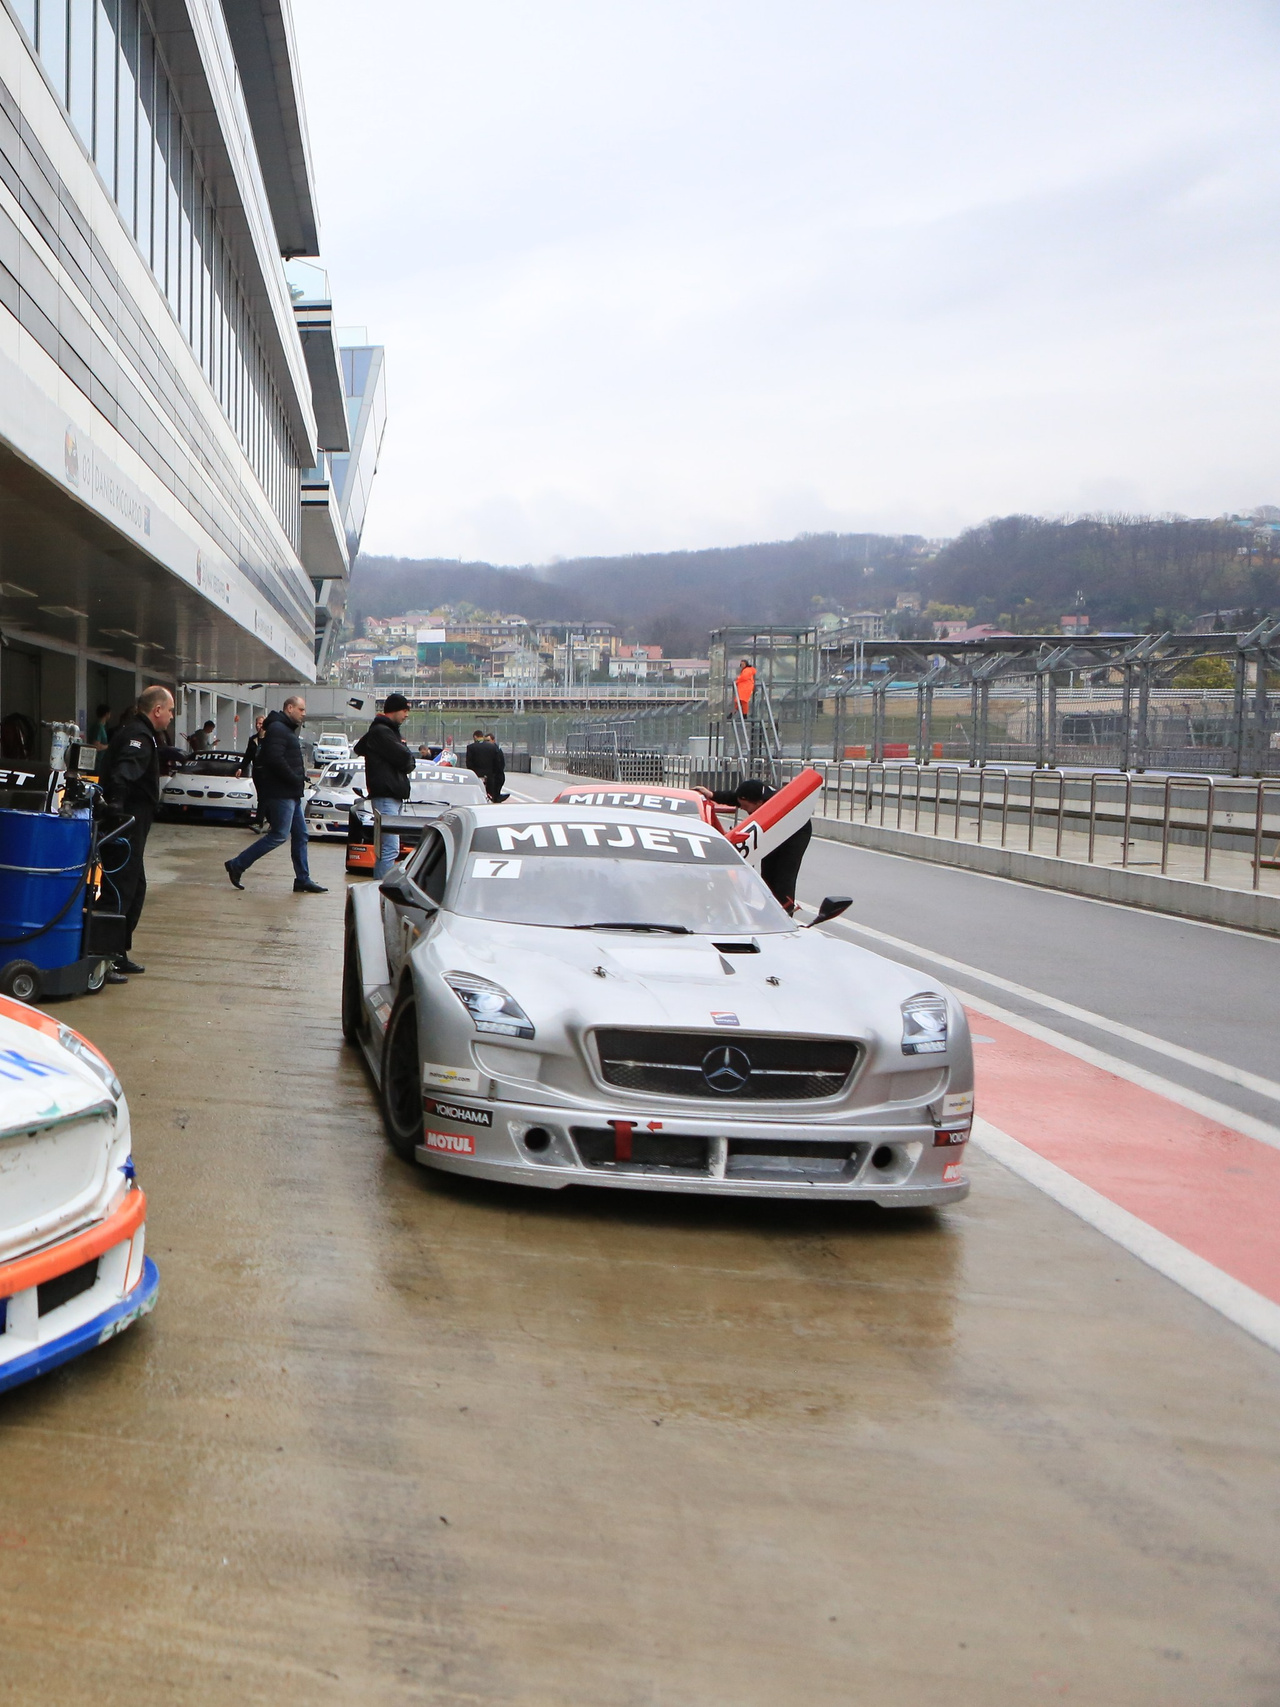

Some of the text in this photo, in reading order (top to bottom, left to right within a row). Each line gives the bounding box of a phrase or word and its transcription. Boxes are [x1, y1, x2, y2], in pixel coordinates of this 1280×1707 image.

[195, 753, 244, 763] MITJET
[407, 770, 468, 783] ITJET
[568, 792, 686, 811] MITJET
[496, 822, 712, 859] MITJET
[490, 859, 510, 878] 7
[435, 1103, 489, 1124] YOKOHAMA
[427, 1132, 472, 1152] MOTUL
